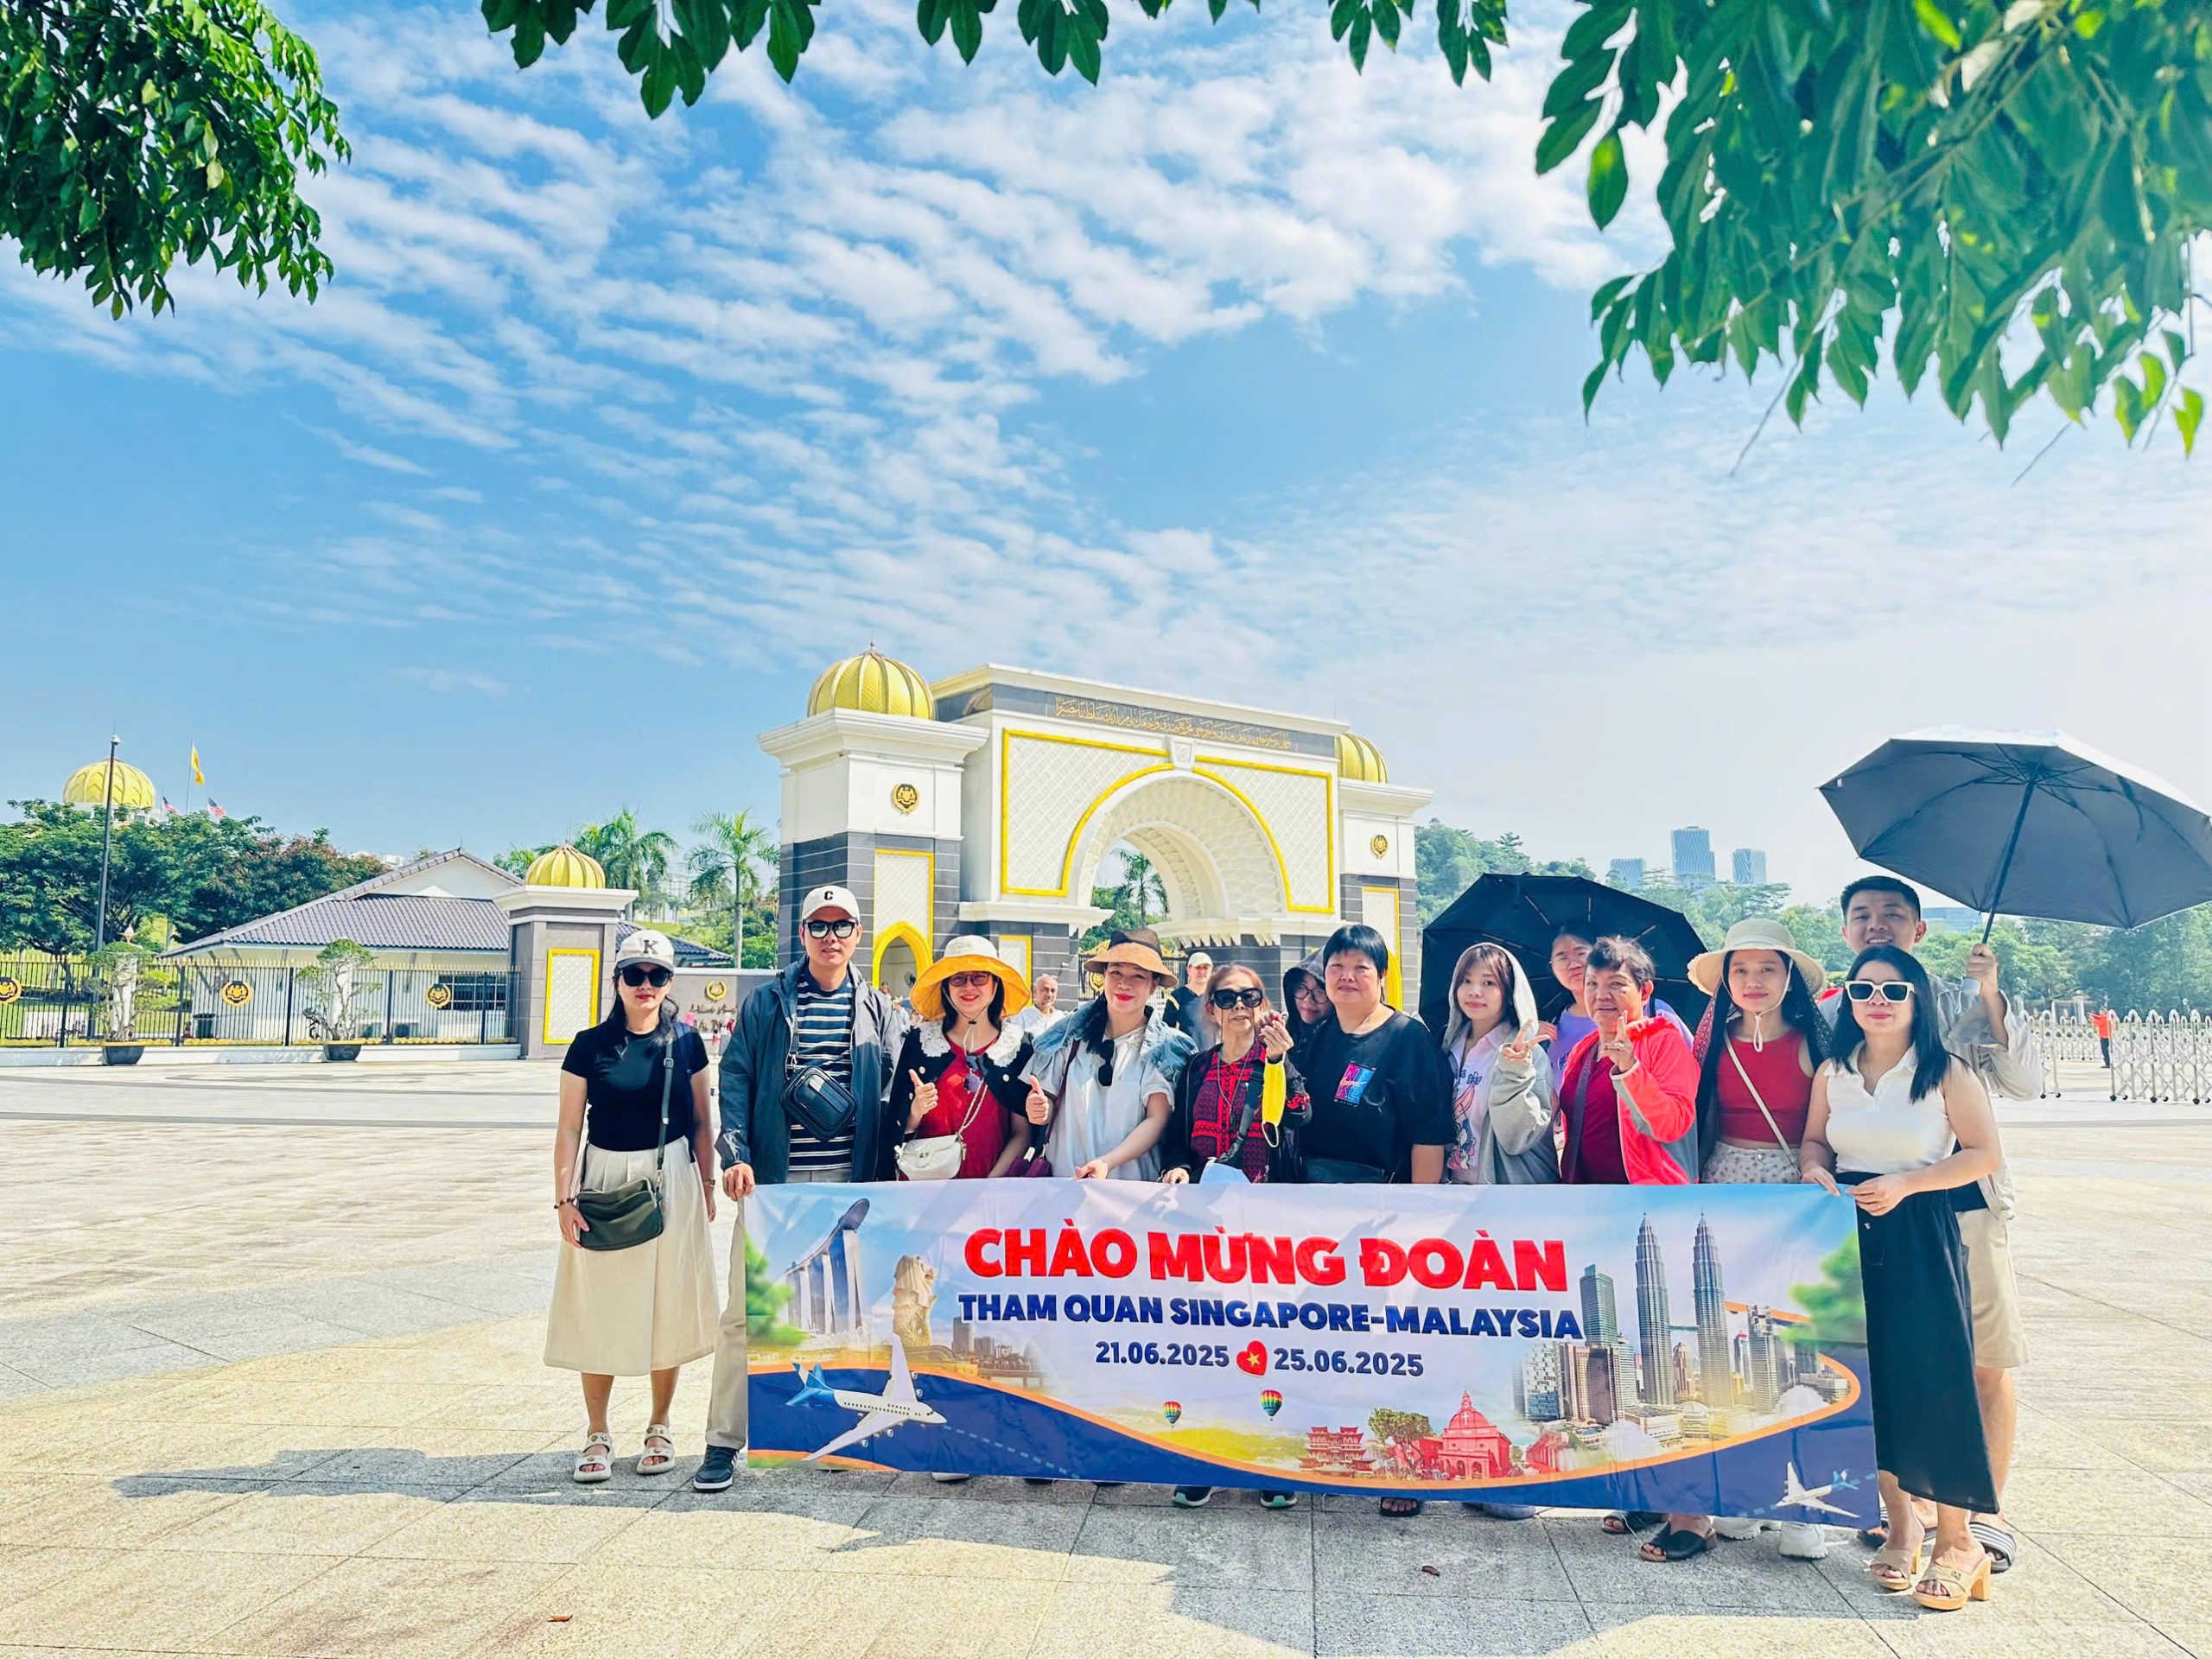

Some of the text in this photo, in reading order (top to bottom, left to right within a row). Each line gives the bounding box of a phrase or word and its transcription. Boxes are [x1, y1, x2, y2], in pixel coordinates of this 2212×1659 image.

[824, 891, 834, 900] C
[643, 939, 659, 955] K
[964, 1218, 1568, 1292] CHÀO MỪNG ĐOÀN
[958, 1294, 1584, 1339] THAM QUAN SINGAPORE-MALAYSIA
[1096, 1341, 1425, 1377] 21.06.2025 25.06.2025
